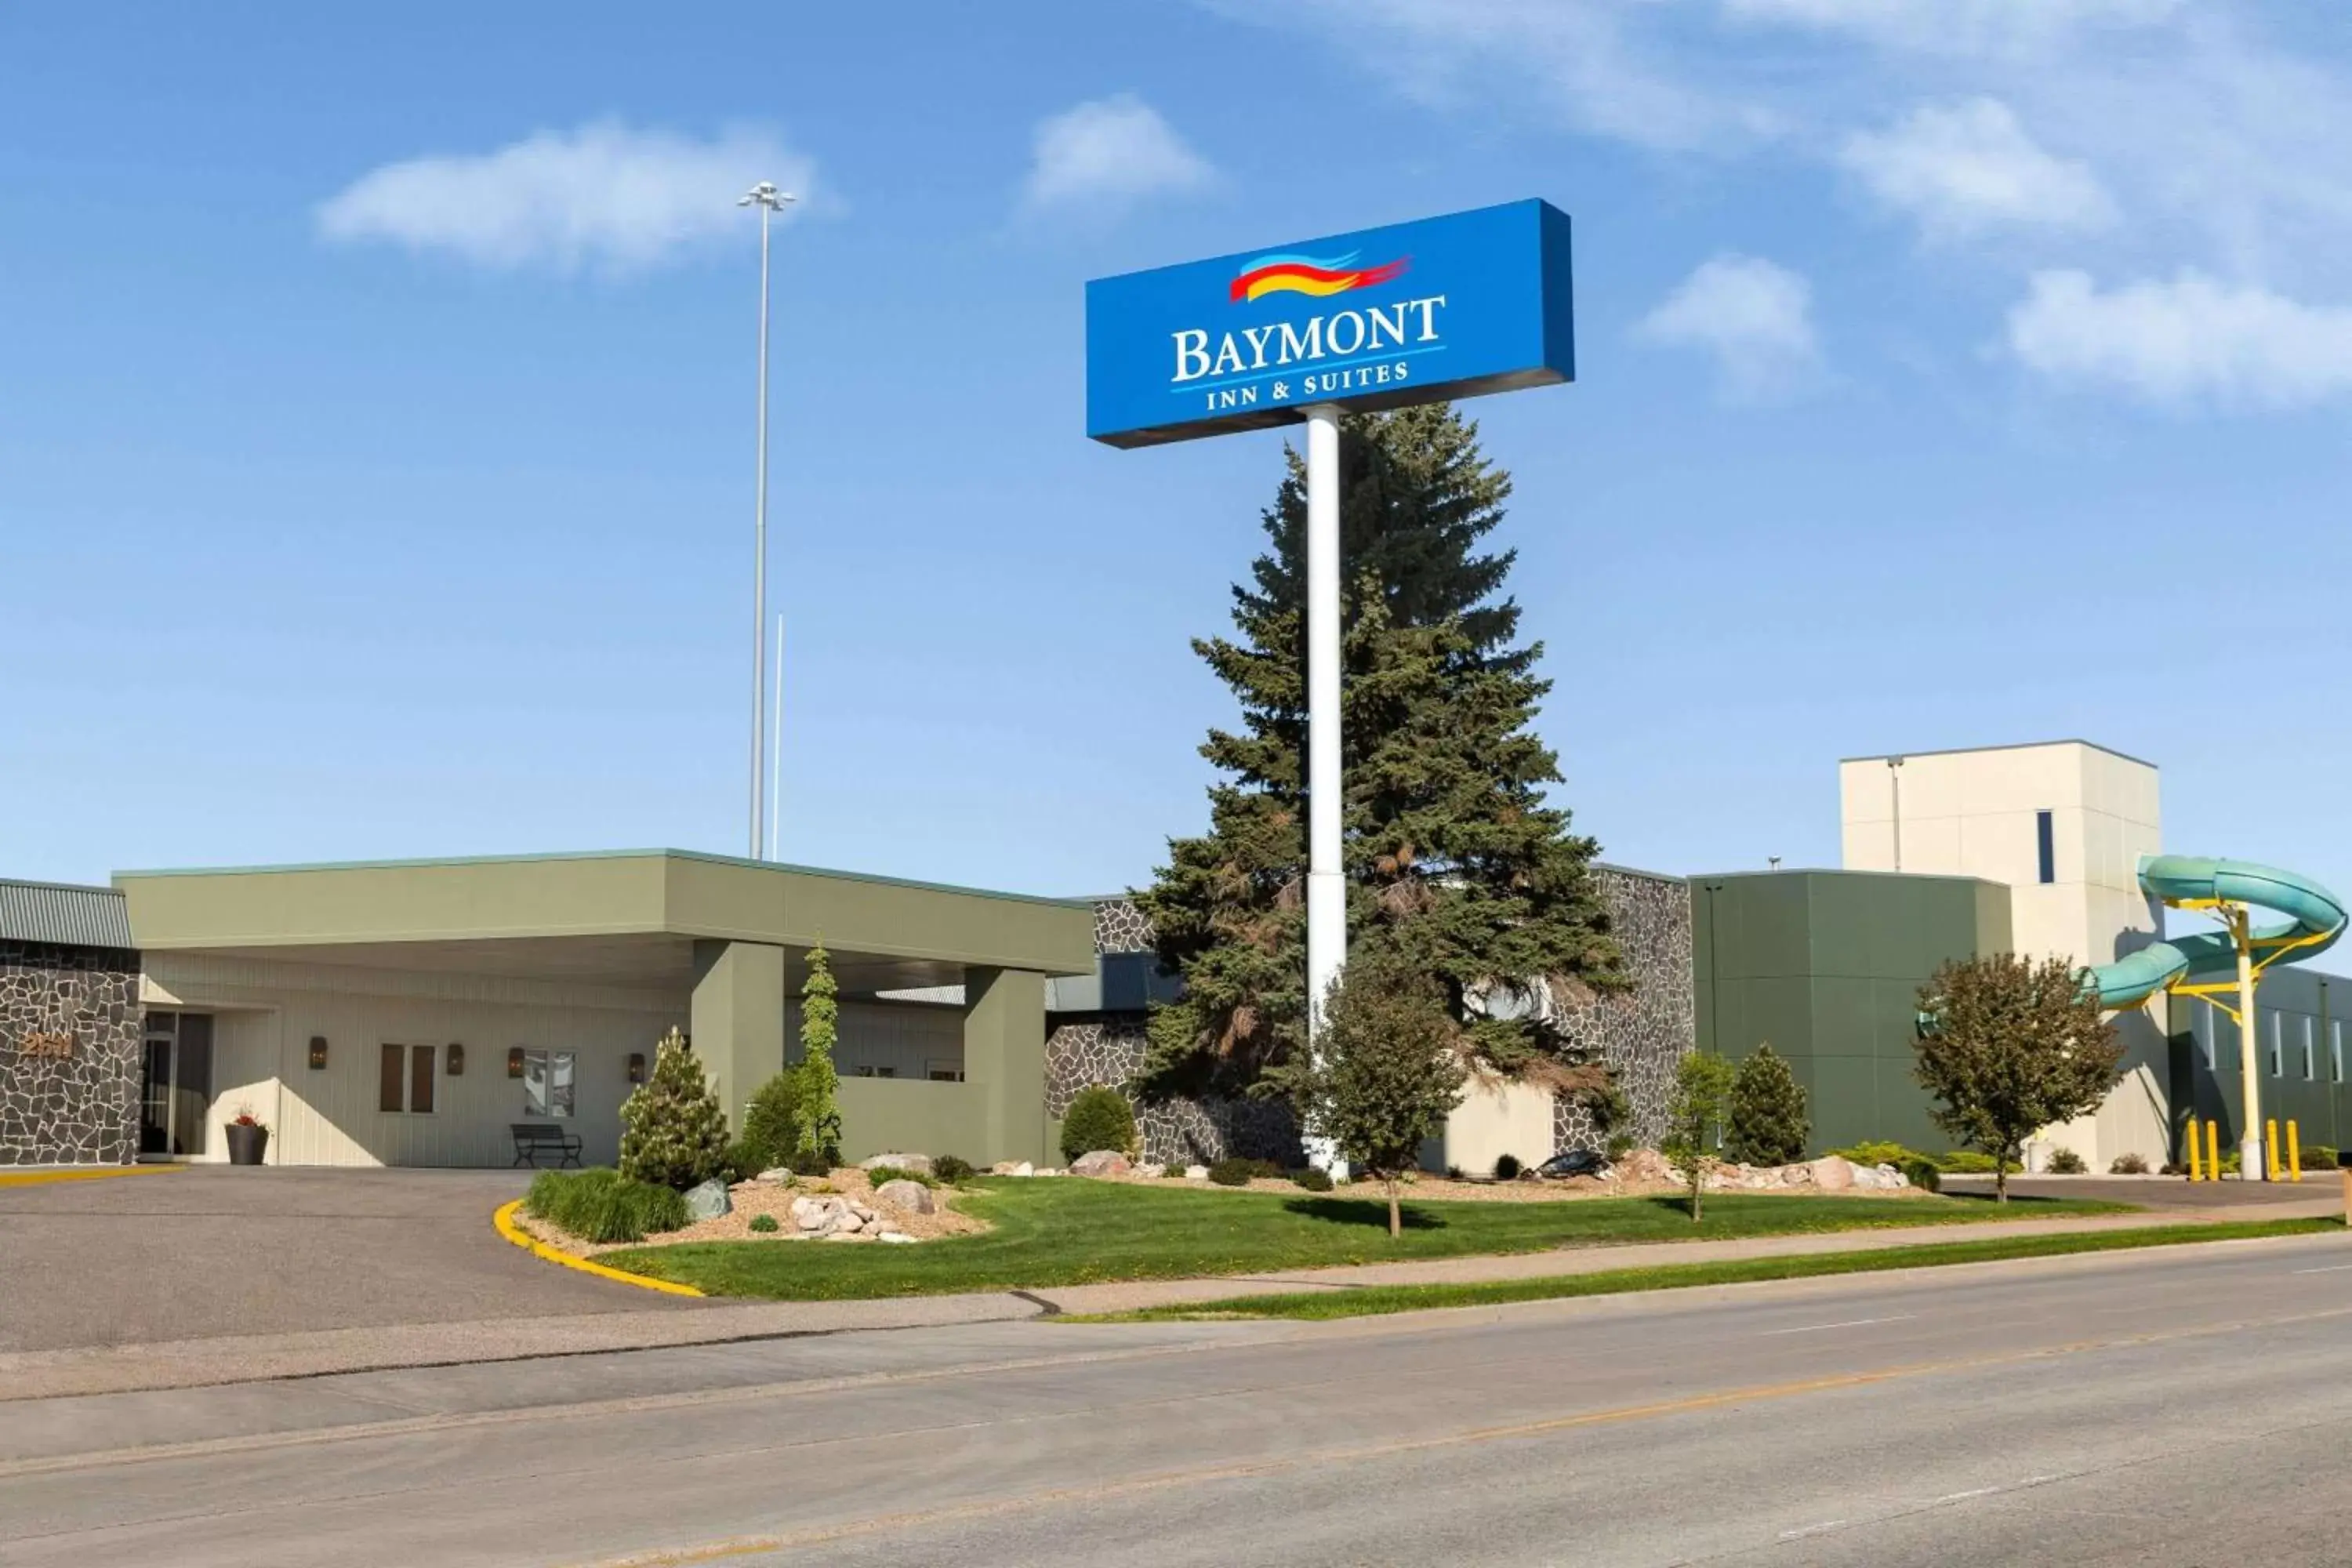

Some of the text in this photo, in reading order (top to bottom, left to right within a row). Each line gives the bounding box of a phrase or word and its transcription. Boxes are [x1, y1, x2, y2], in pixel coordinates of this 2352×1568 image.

[1171, 294, 1446, 383] BAYMONT
[1207, 361, 1409, 411] INN & SUITES
